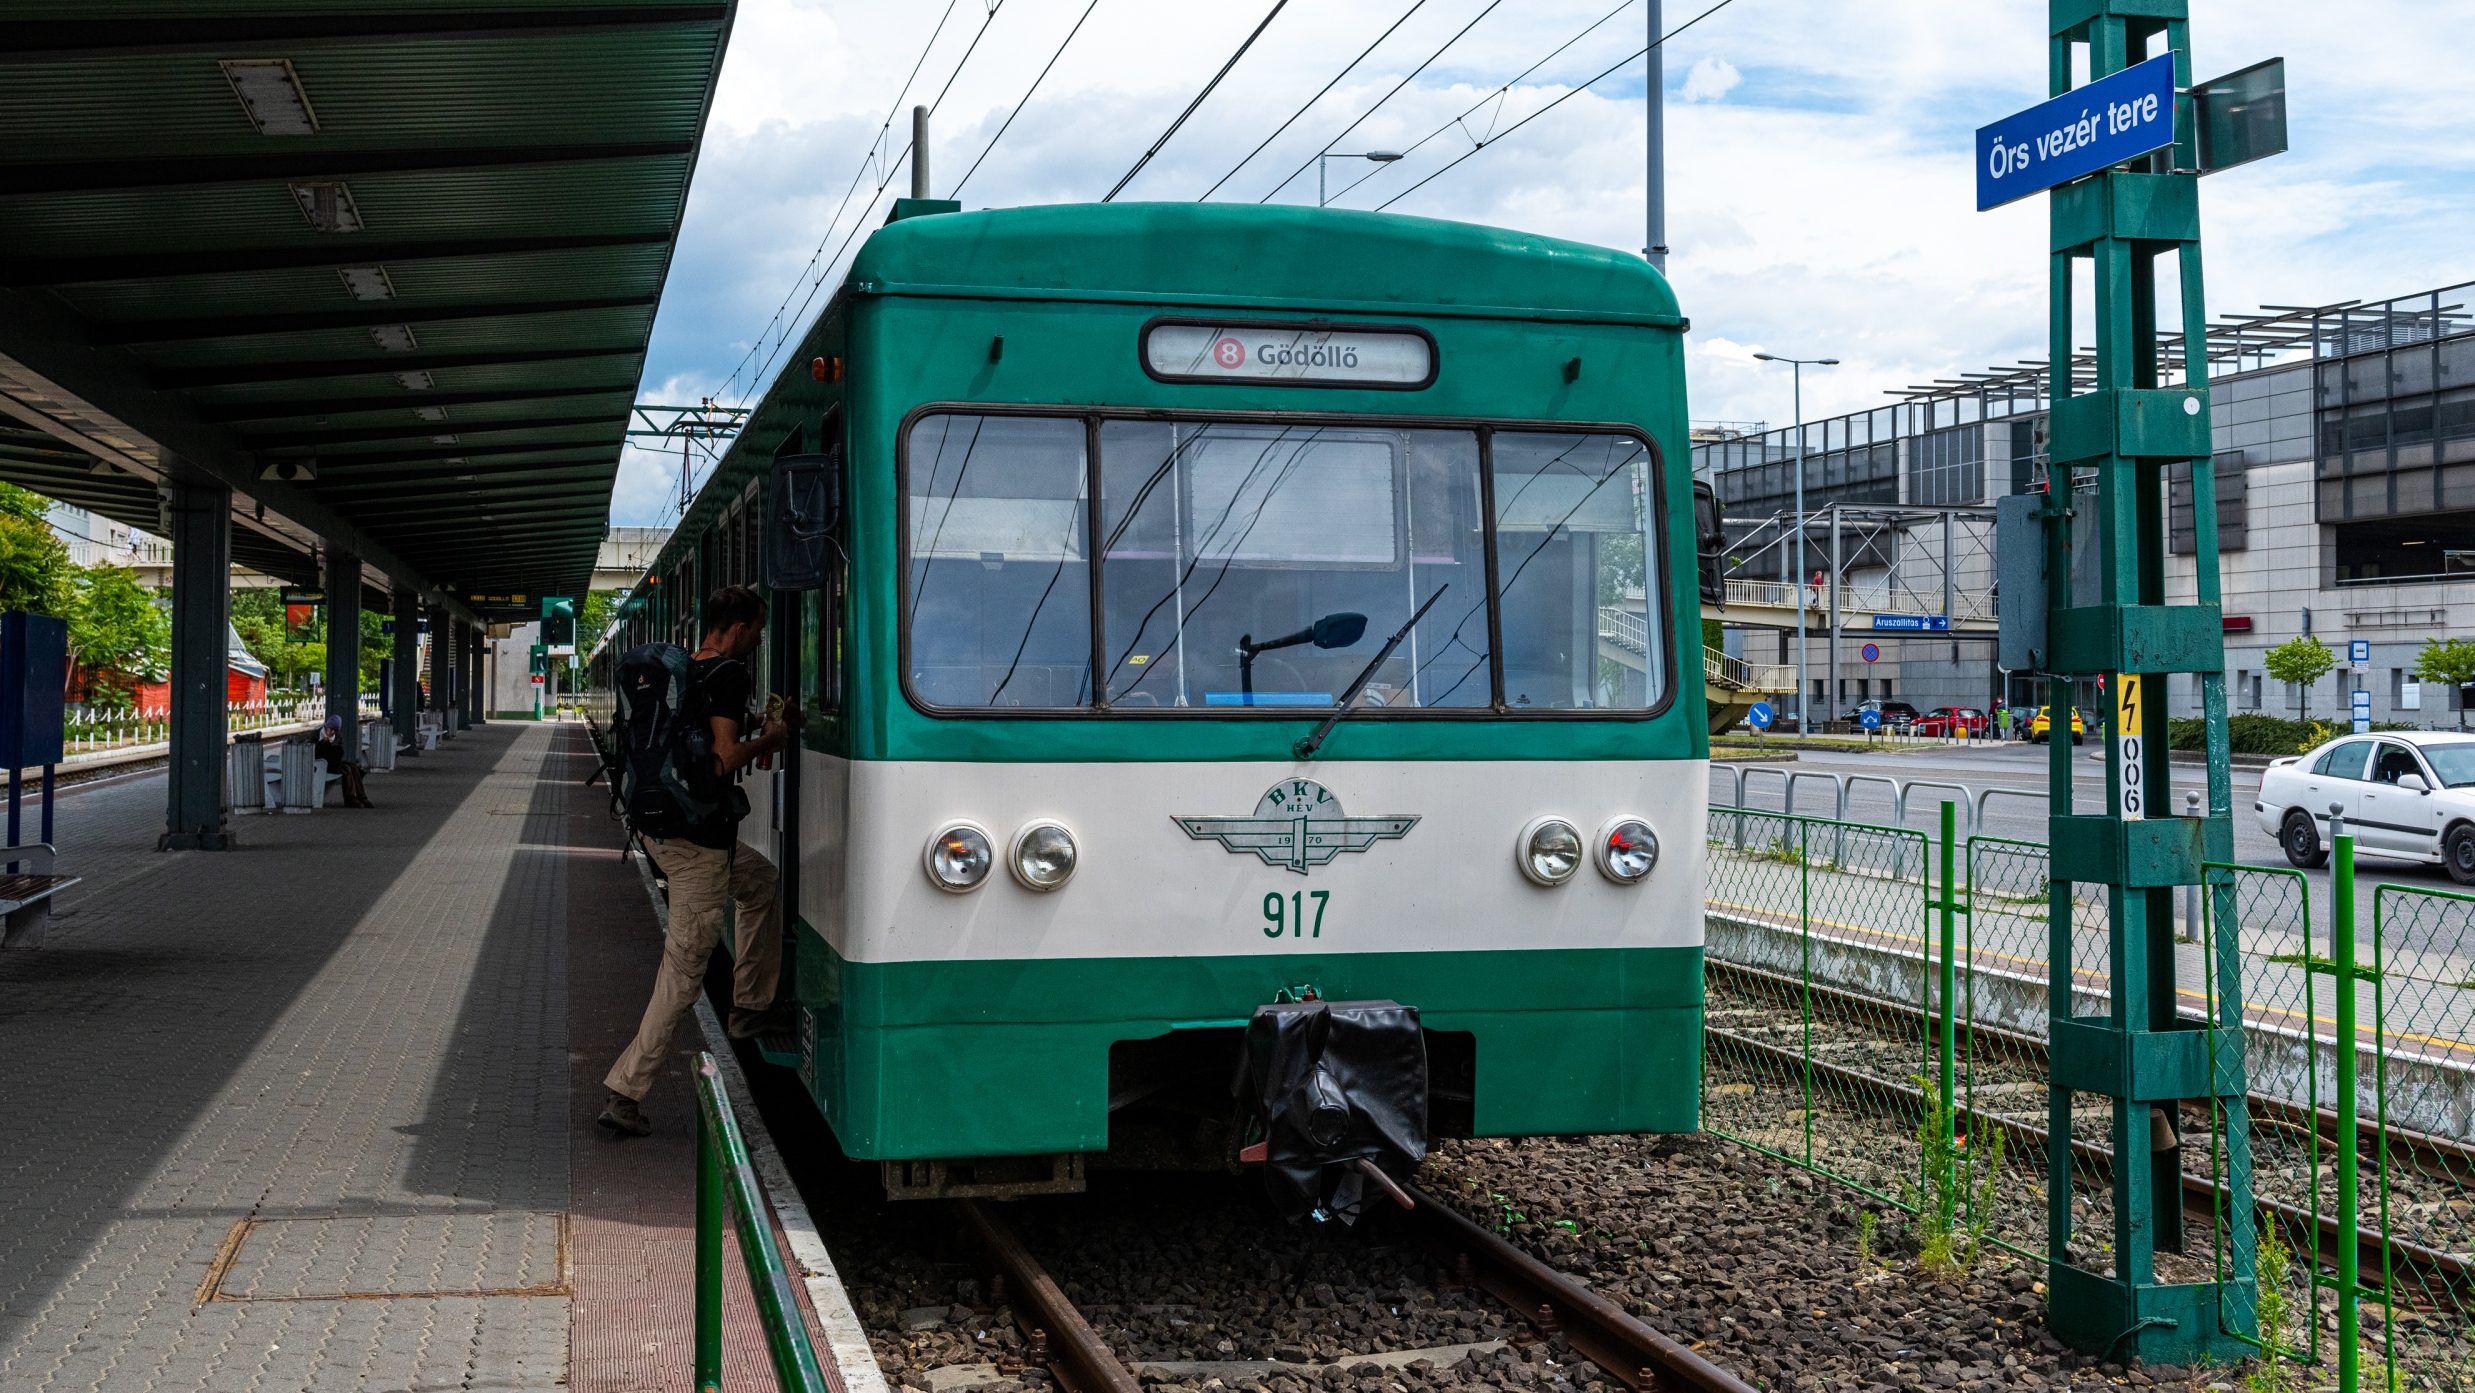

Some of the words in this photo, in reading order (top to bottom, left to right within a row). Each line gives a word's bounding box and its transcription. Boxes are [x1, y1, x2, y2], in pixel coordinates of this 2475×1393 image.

[1989, 135, 2030, 180] Örs
[2036, 107, 2101, 162] vezér
[2107, 92, 2158, 136] tere
[1220, 342, 1239, 364] 8
[1257, 343, 1359, 368] Gödöllő
[1267, 781, 1334, 807] BKV
[2123, 737, 2140, 813] 006
[1263, 890, 1330, 938] 917
